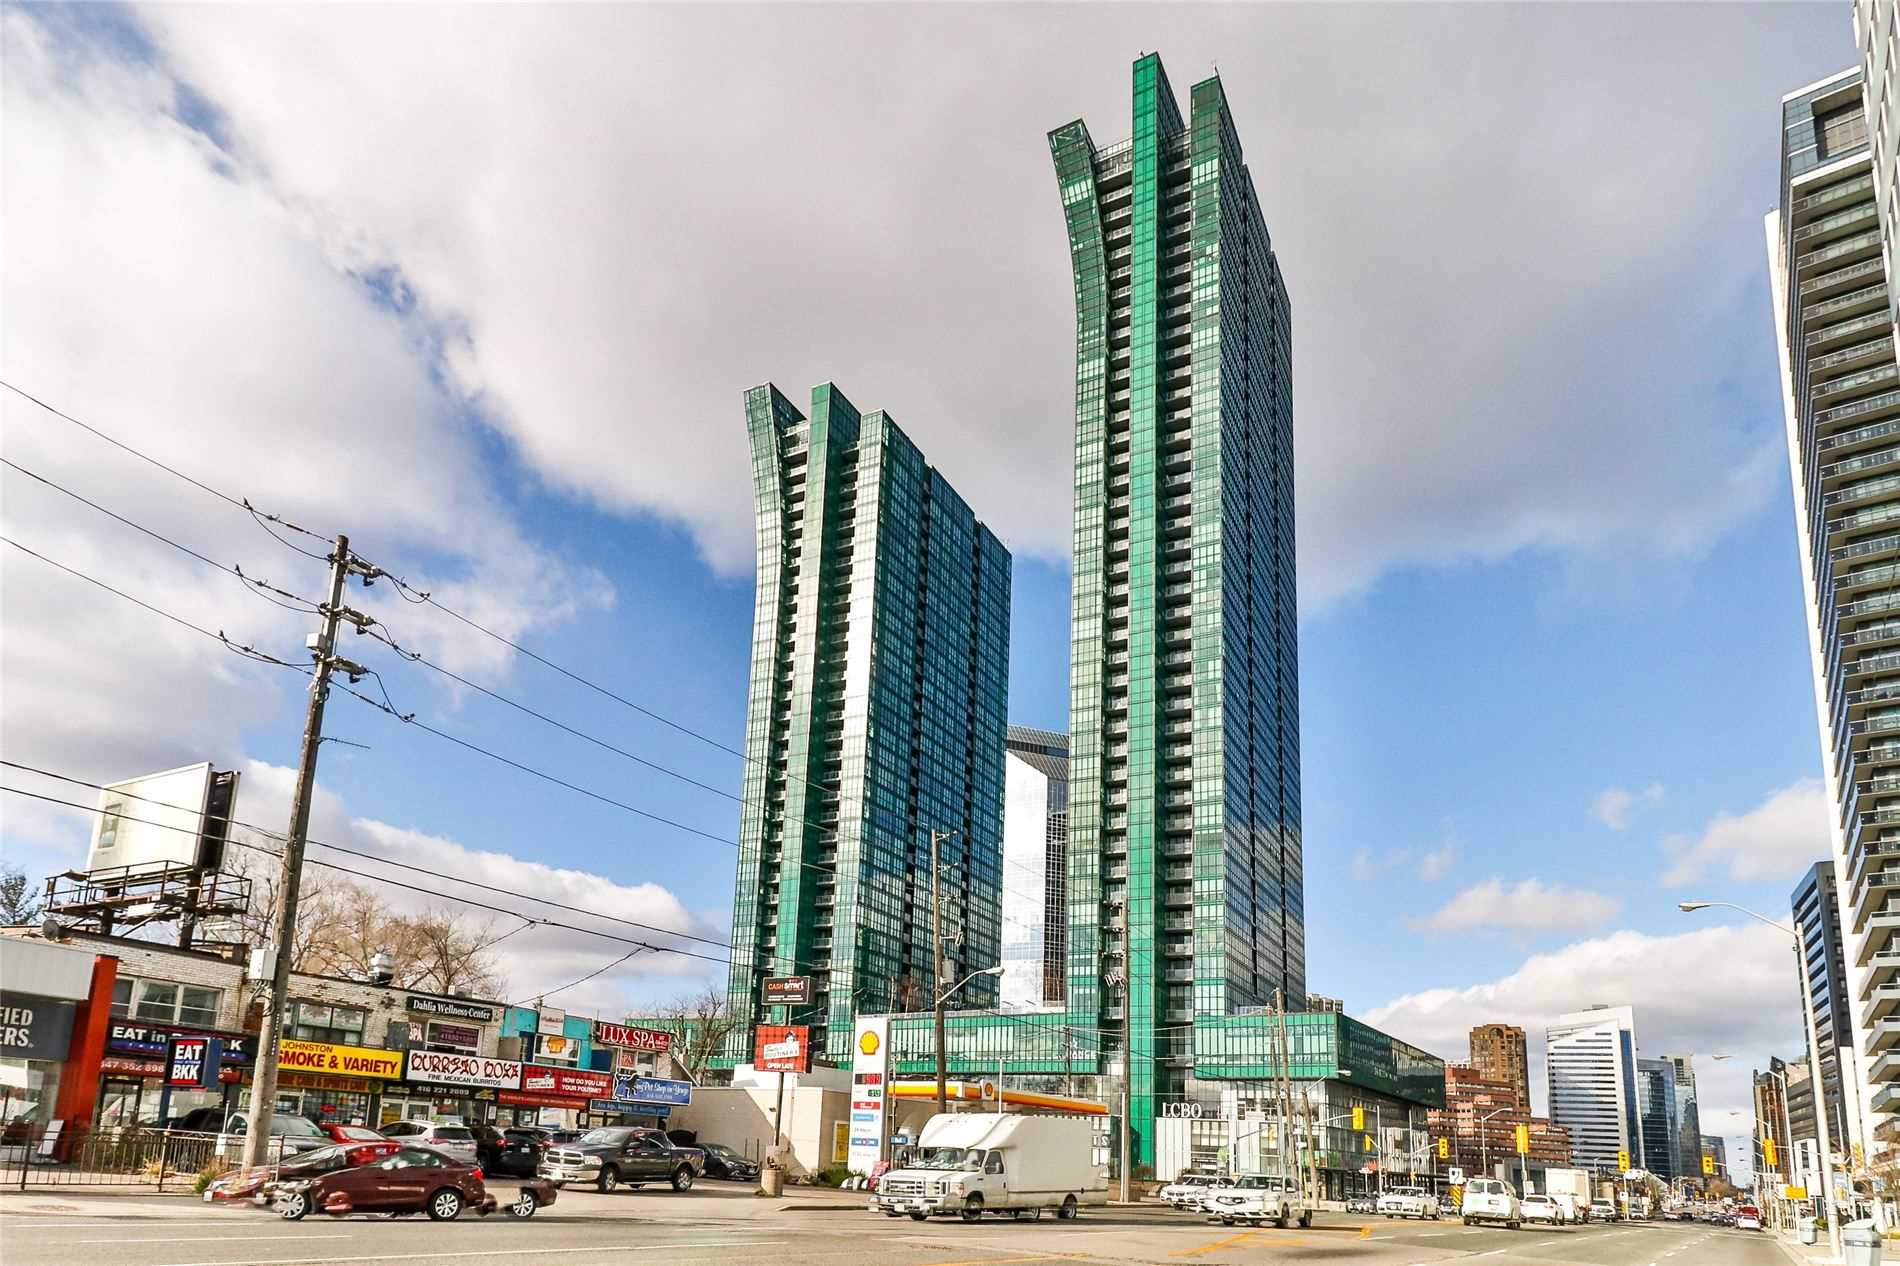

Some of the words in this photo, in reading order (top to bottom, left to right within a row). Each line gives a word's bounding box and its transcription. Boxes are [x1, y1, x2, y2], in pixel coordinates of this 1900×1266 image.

[413, 1000, 437, 1012] Dahlia
[437, 1003, 468, 1017] Wellness
[468, 1008, 491, 1020] Center
[112, 1026, 147, 1041] EAT
[151, 1030, 167, 1043] in
[601, 1025, 630, 1045] LUX
[631, 1030, 656, 1049] SPA
[174, 1044, 204, 1060] EAT
[282, 1041, 334, 1053] JOHNSTON
[171, 1063, 200, 1080] BKK
[328, 1055, 339, 1069] &
[343, 1056, 398, 1074] VARIETY
[427, 1073, 441, 1081] FINE
[444, 1075, 471, 1083] MEXICAN
[472, 1078, 502, 1087] BURRITOS
[1162, 1102, 1202, 1118] LCBO
